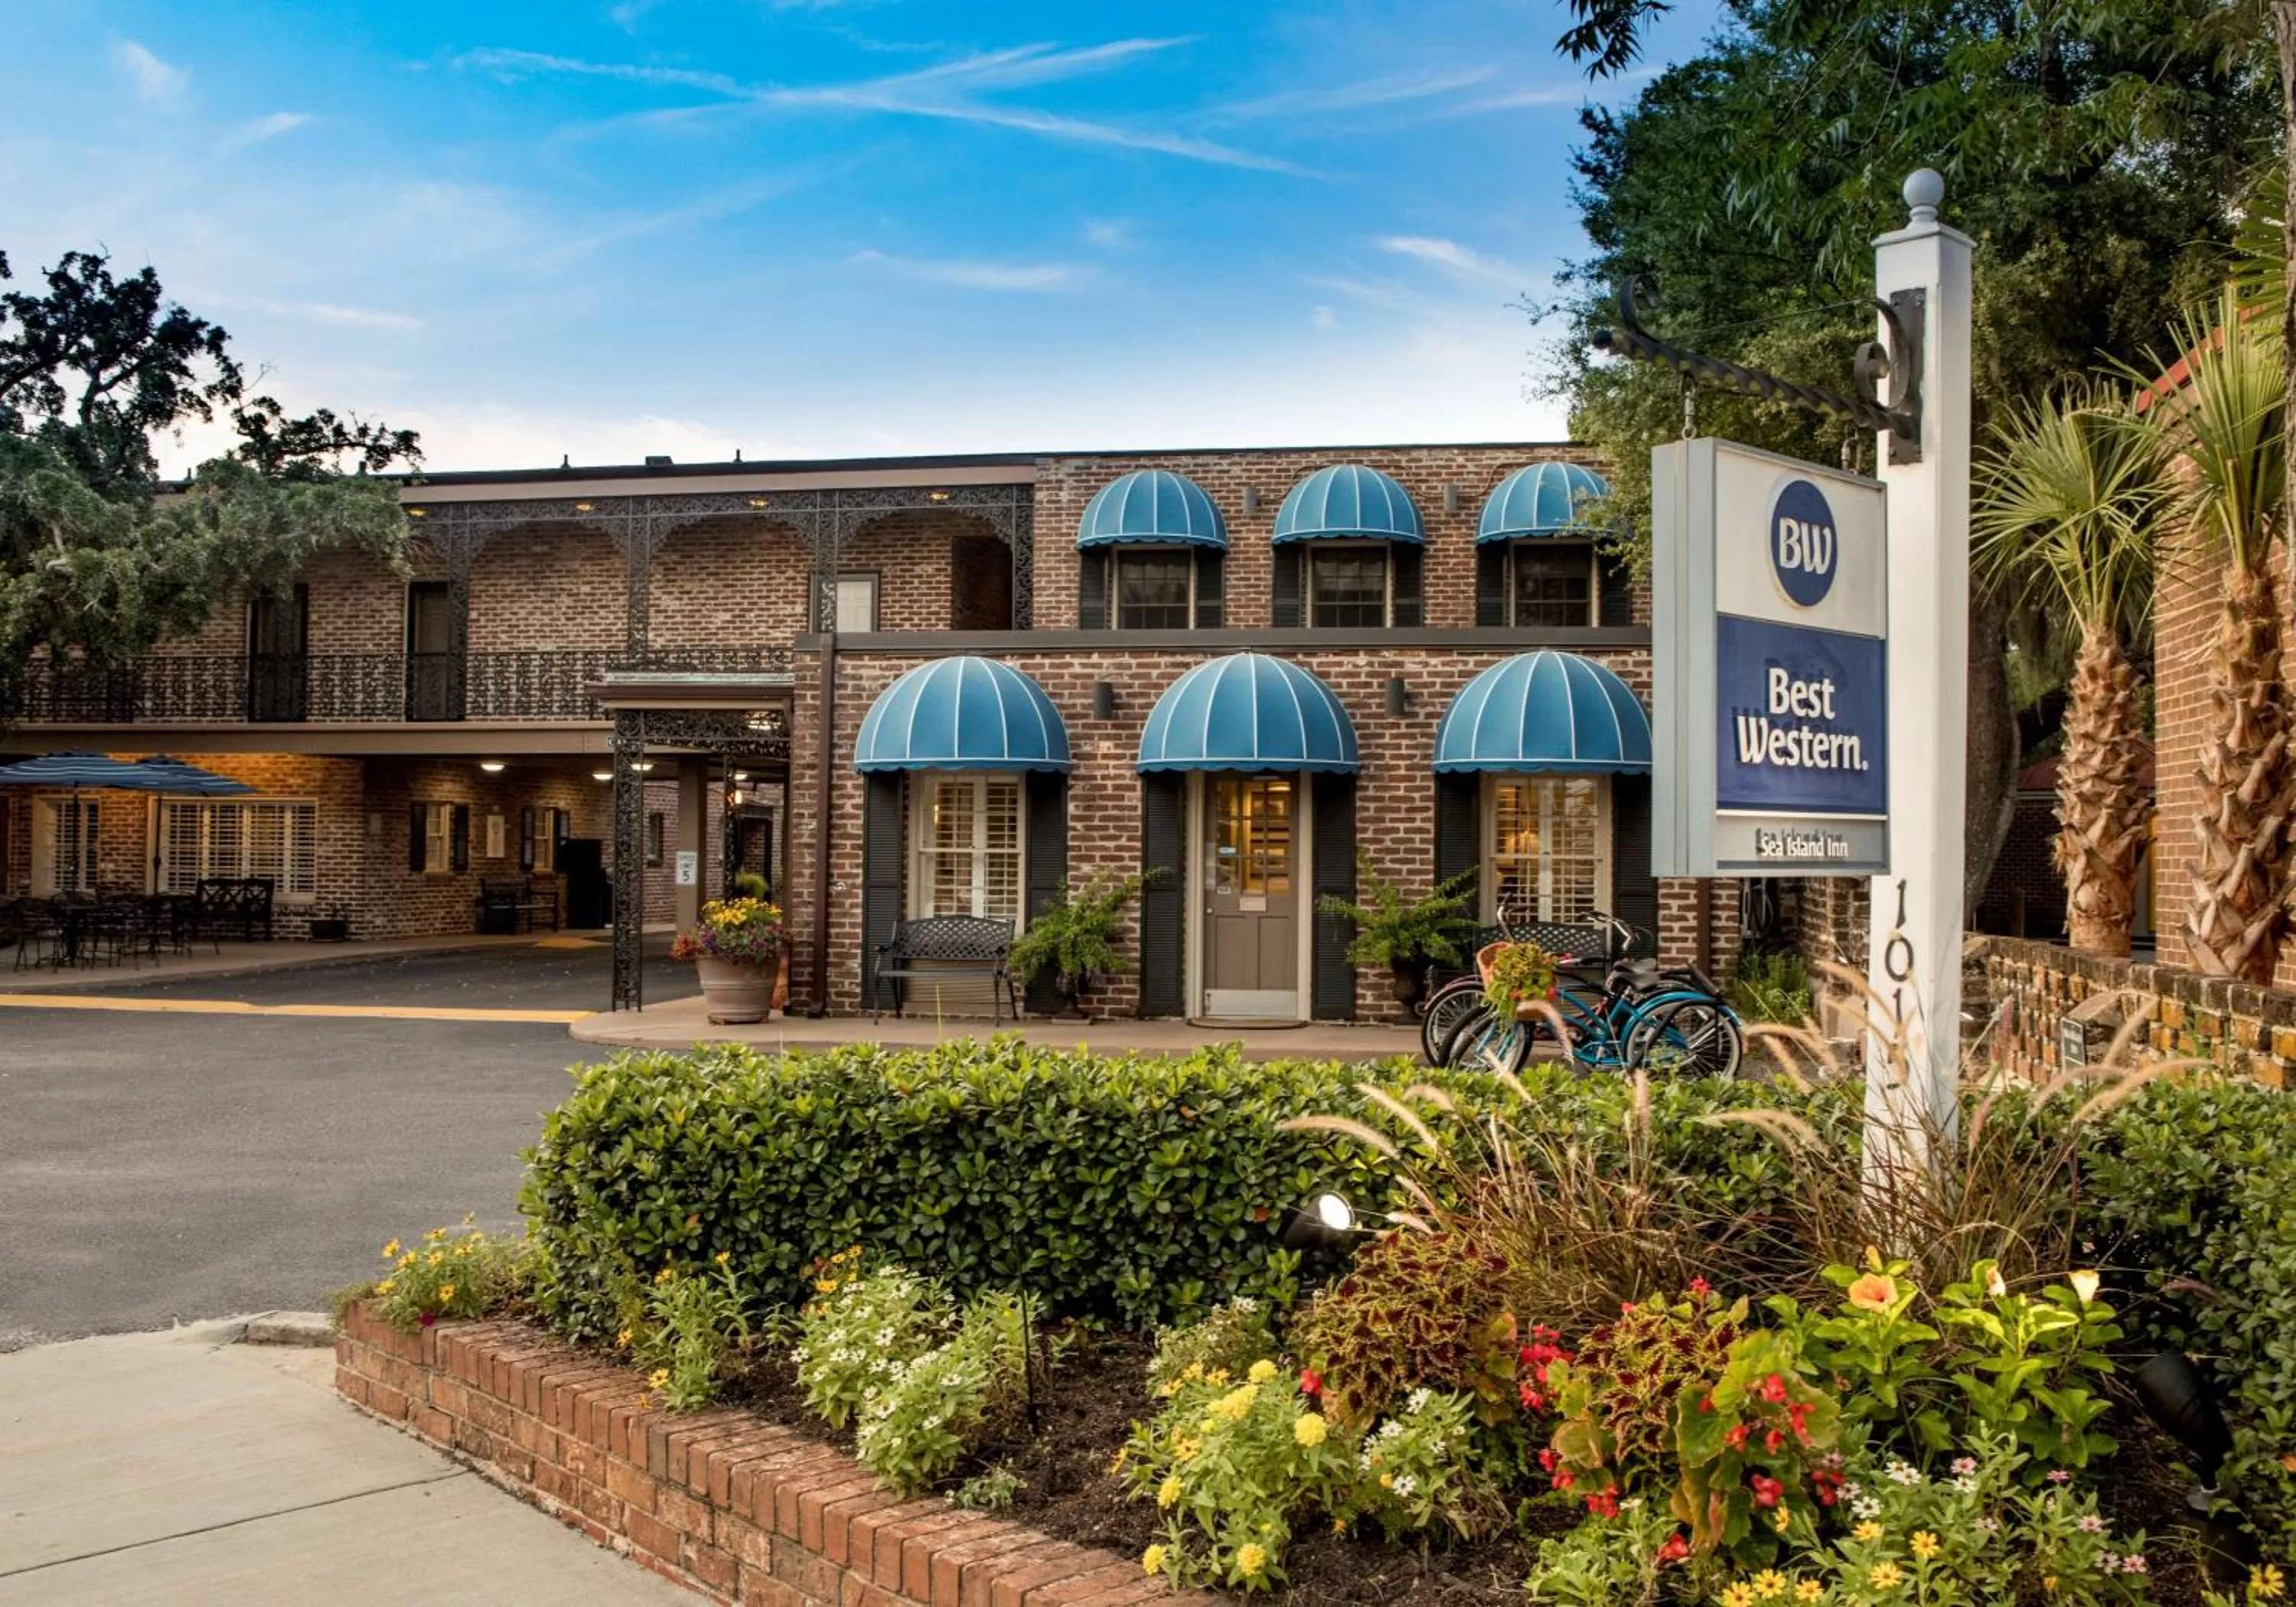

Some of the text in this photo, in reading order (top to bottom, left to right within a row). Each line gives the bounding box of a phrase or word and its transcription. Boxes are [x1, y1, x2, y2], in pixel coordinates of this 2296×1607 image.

[1779, 517, 1831, 574] BW
[1769, 667, 1835, 719] Best
[1737, 715, 1868, 771] Western.
[1761, 836, 1848, 857] Sea Island Inn
[683, 870, 690, 882] 5
